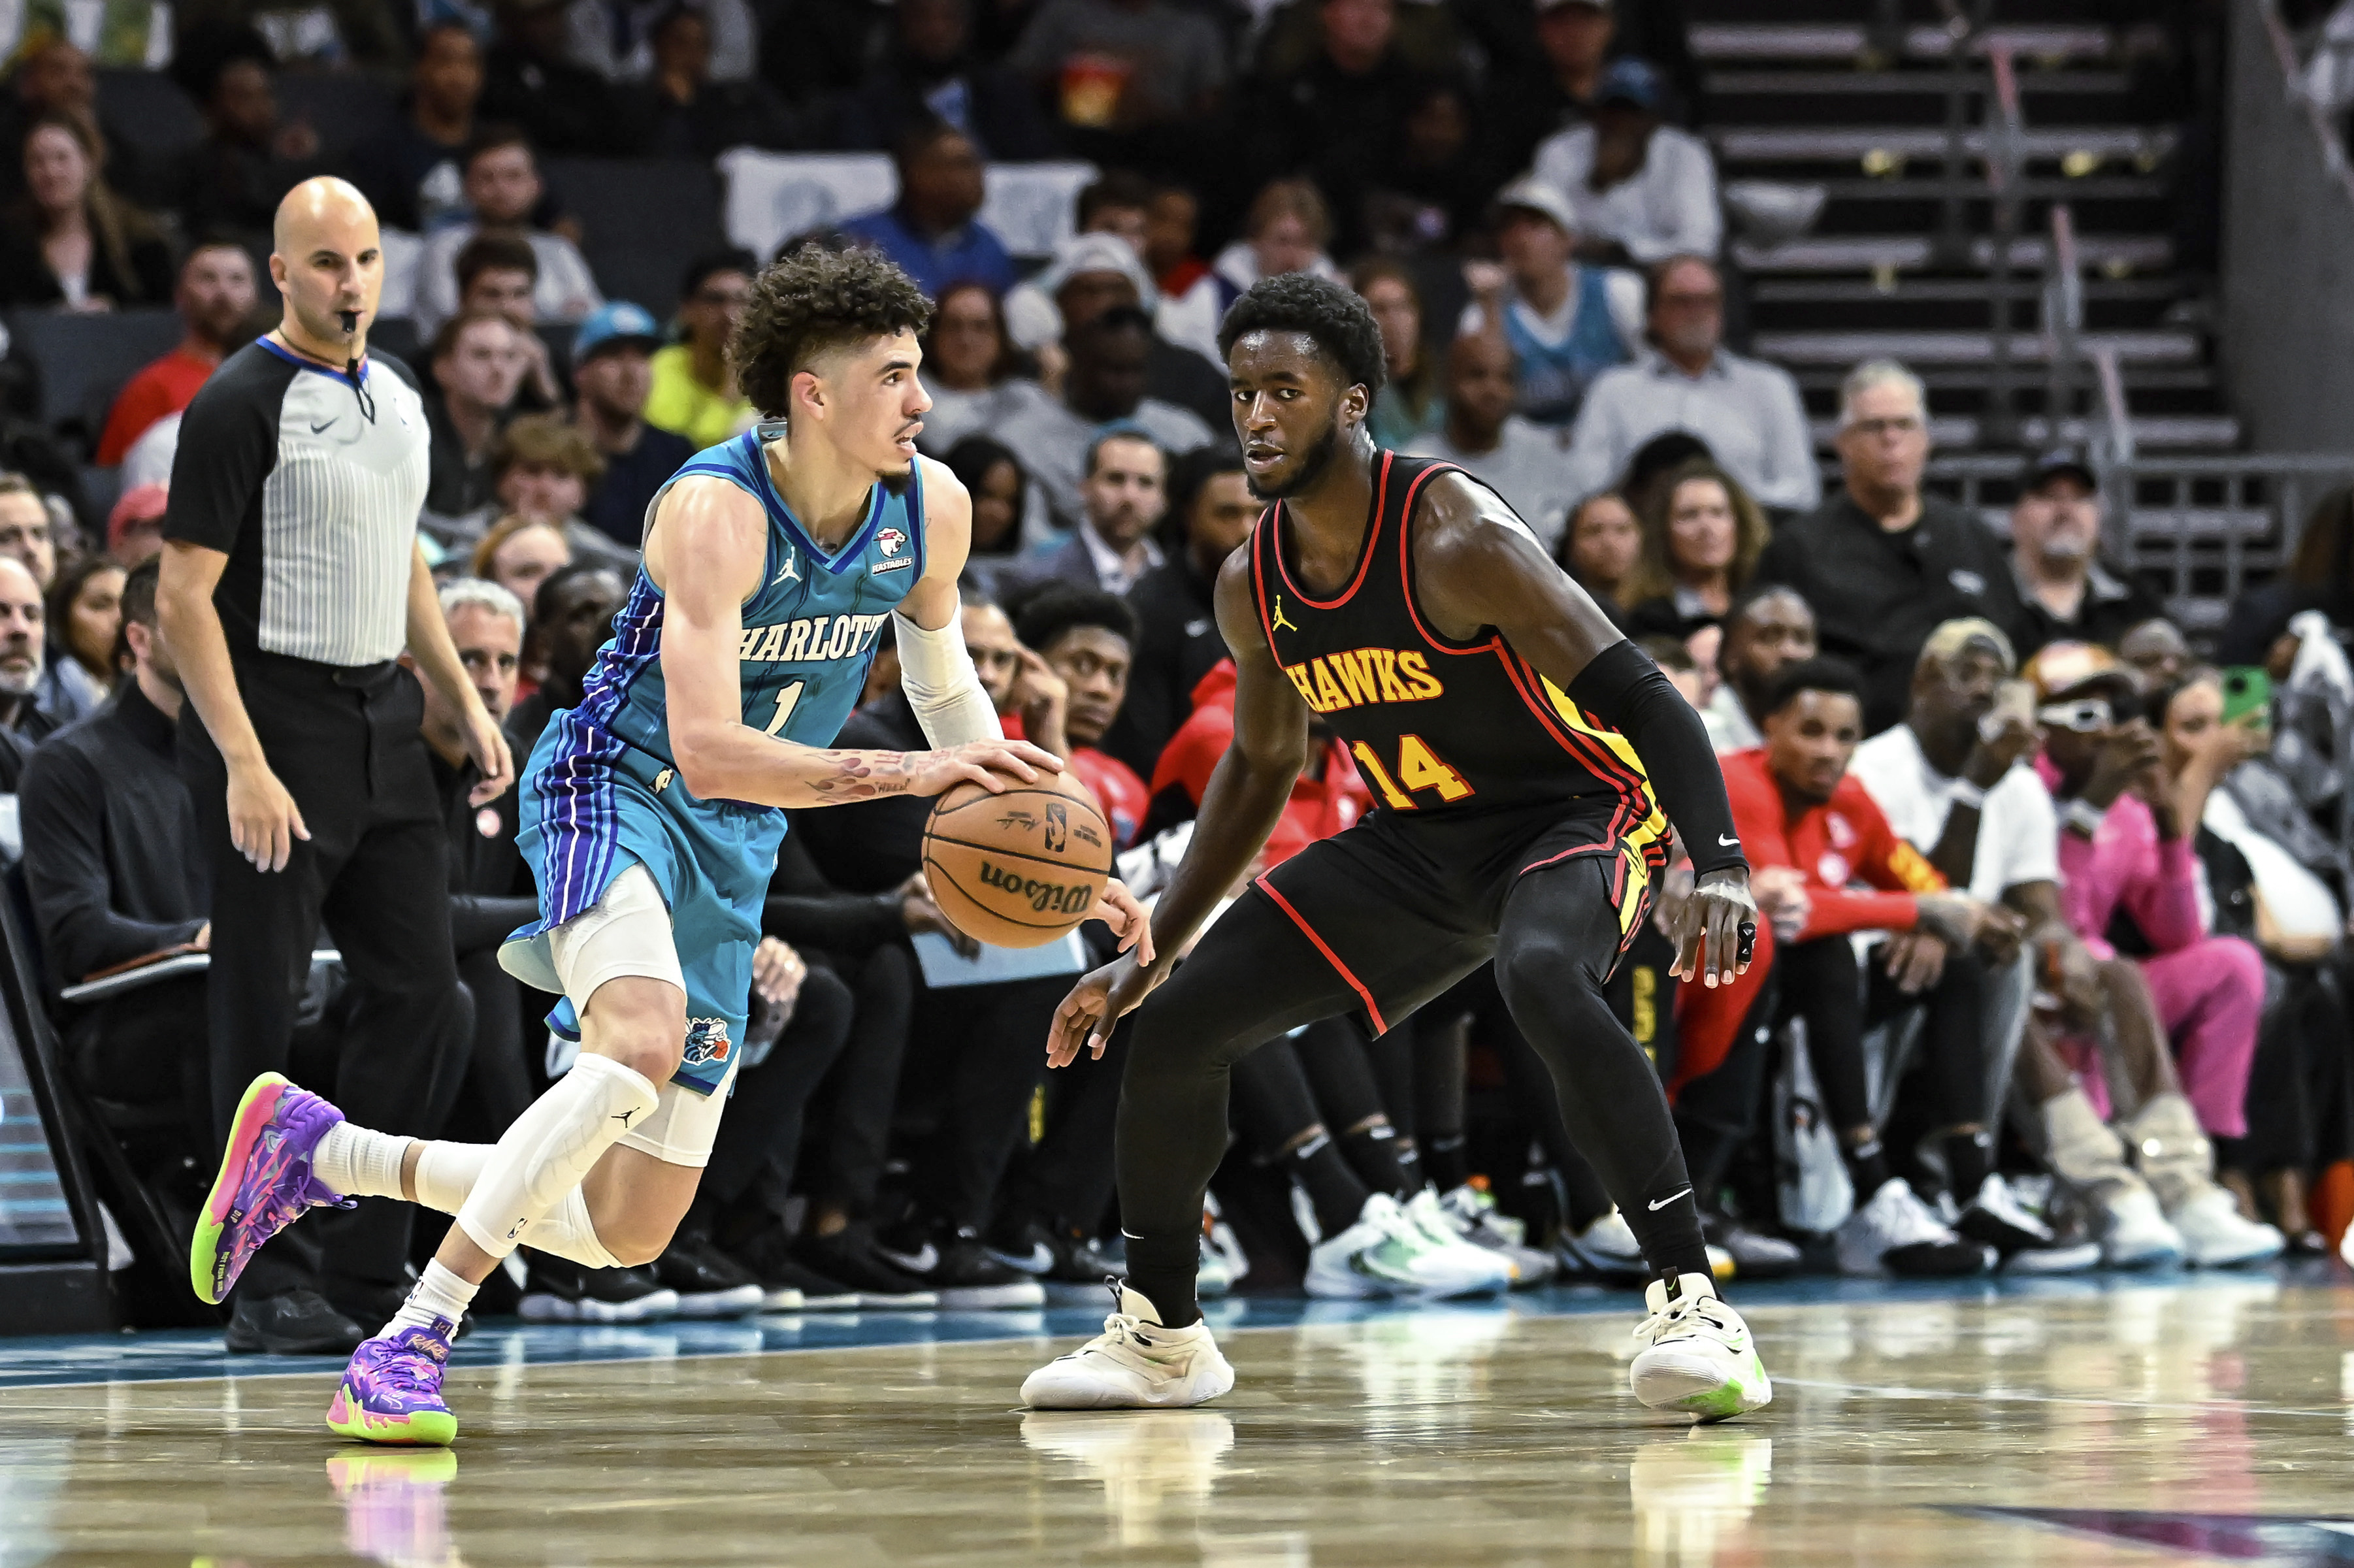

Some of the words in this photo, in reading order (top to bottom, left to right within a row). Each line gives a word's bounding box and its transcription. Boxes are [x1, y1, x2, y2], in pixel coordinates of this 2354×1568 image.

[872, 557, 913, 574] FEASTABLES
[739, 612, 891, 661] HARLOTT
[1285, 647, 1445, 713] HAWKS
[764, 680, 805, 735] 1
[1350, 734, 1476, 810] 14
[981, 861, 1092, 914] Wilson
